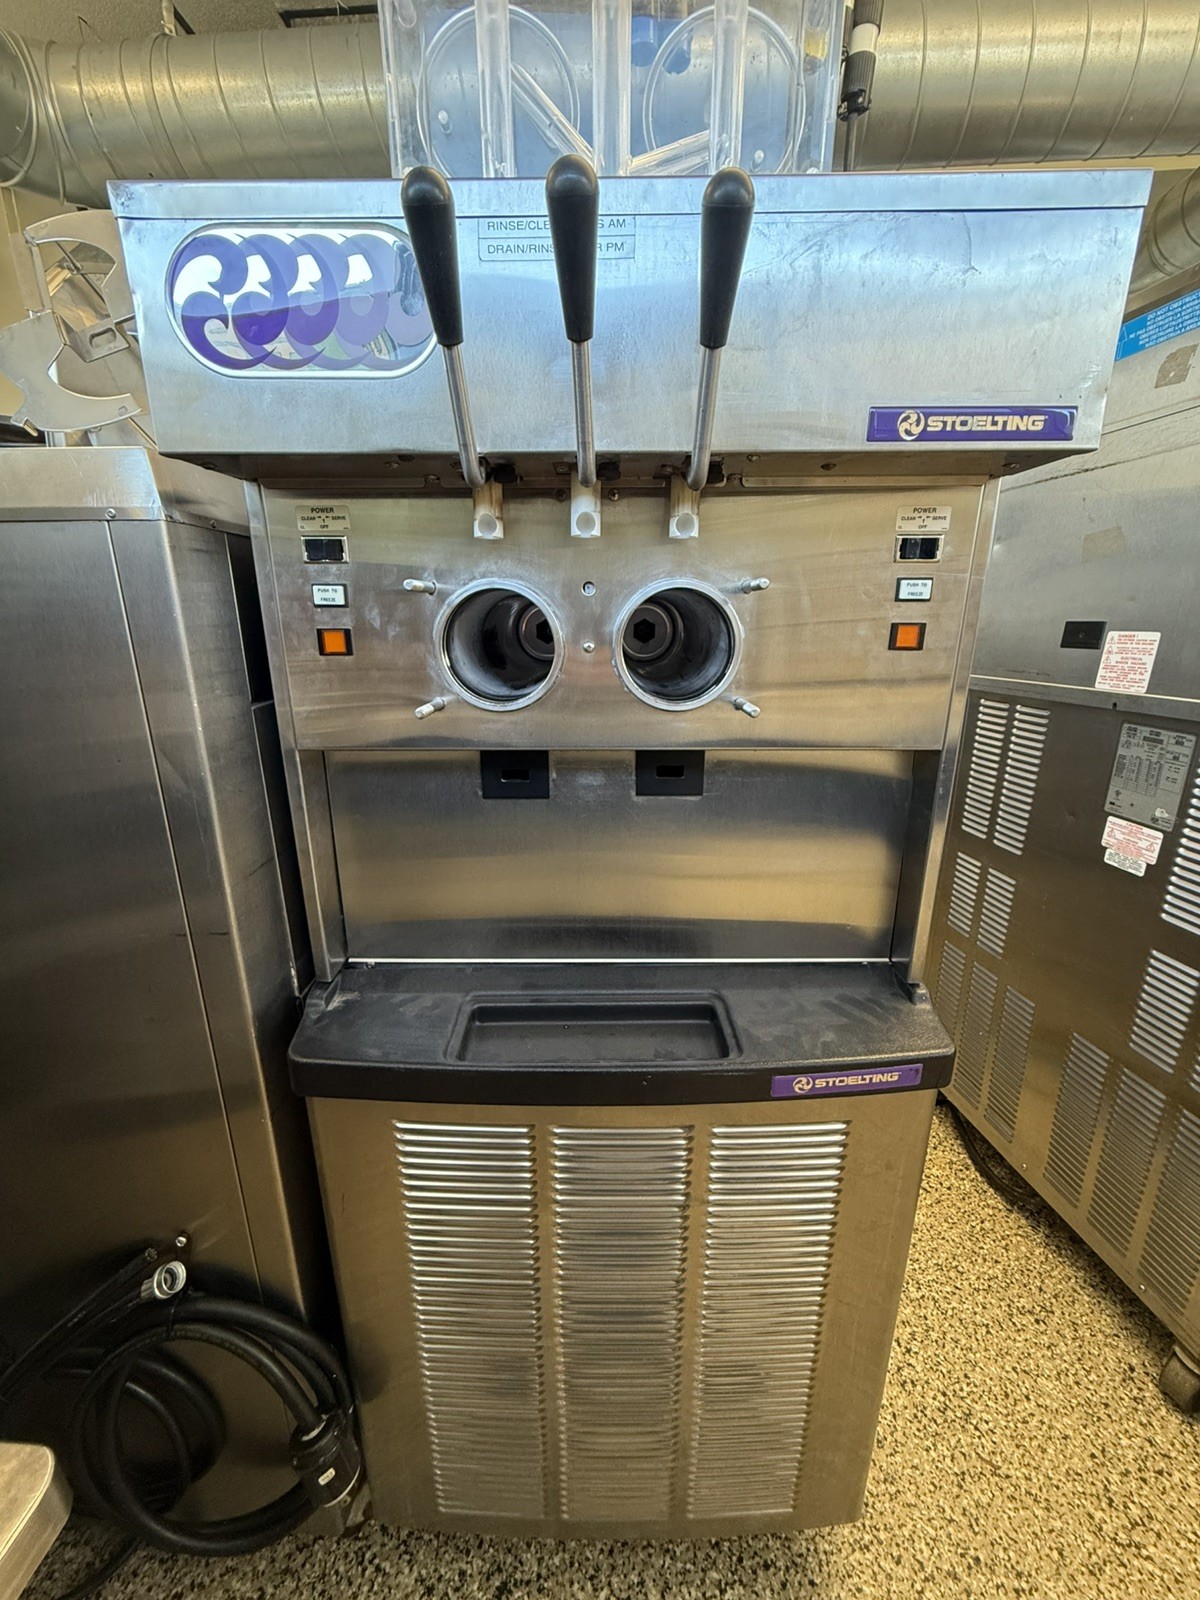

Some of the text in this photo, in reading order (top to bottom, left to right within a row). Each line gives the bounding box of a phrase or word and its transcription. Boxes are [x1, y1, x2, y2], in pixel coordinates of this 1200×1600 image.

[487, 219, 550, 231] RINSE/CLE
[608, 218, 626, 228] AM
[487, 243, 555, 254] DRAIN/RINS
[606, 242, 625, 252] PM
[926, 414, 1045, 432] STOELTING
[815, 1072, 900, 1088] STOELTING
